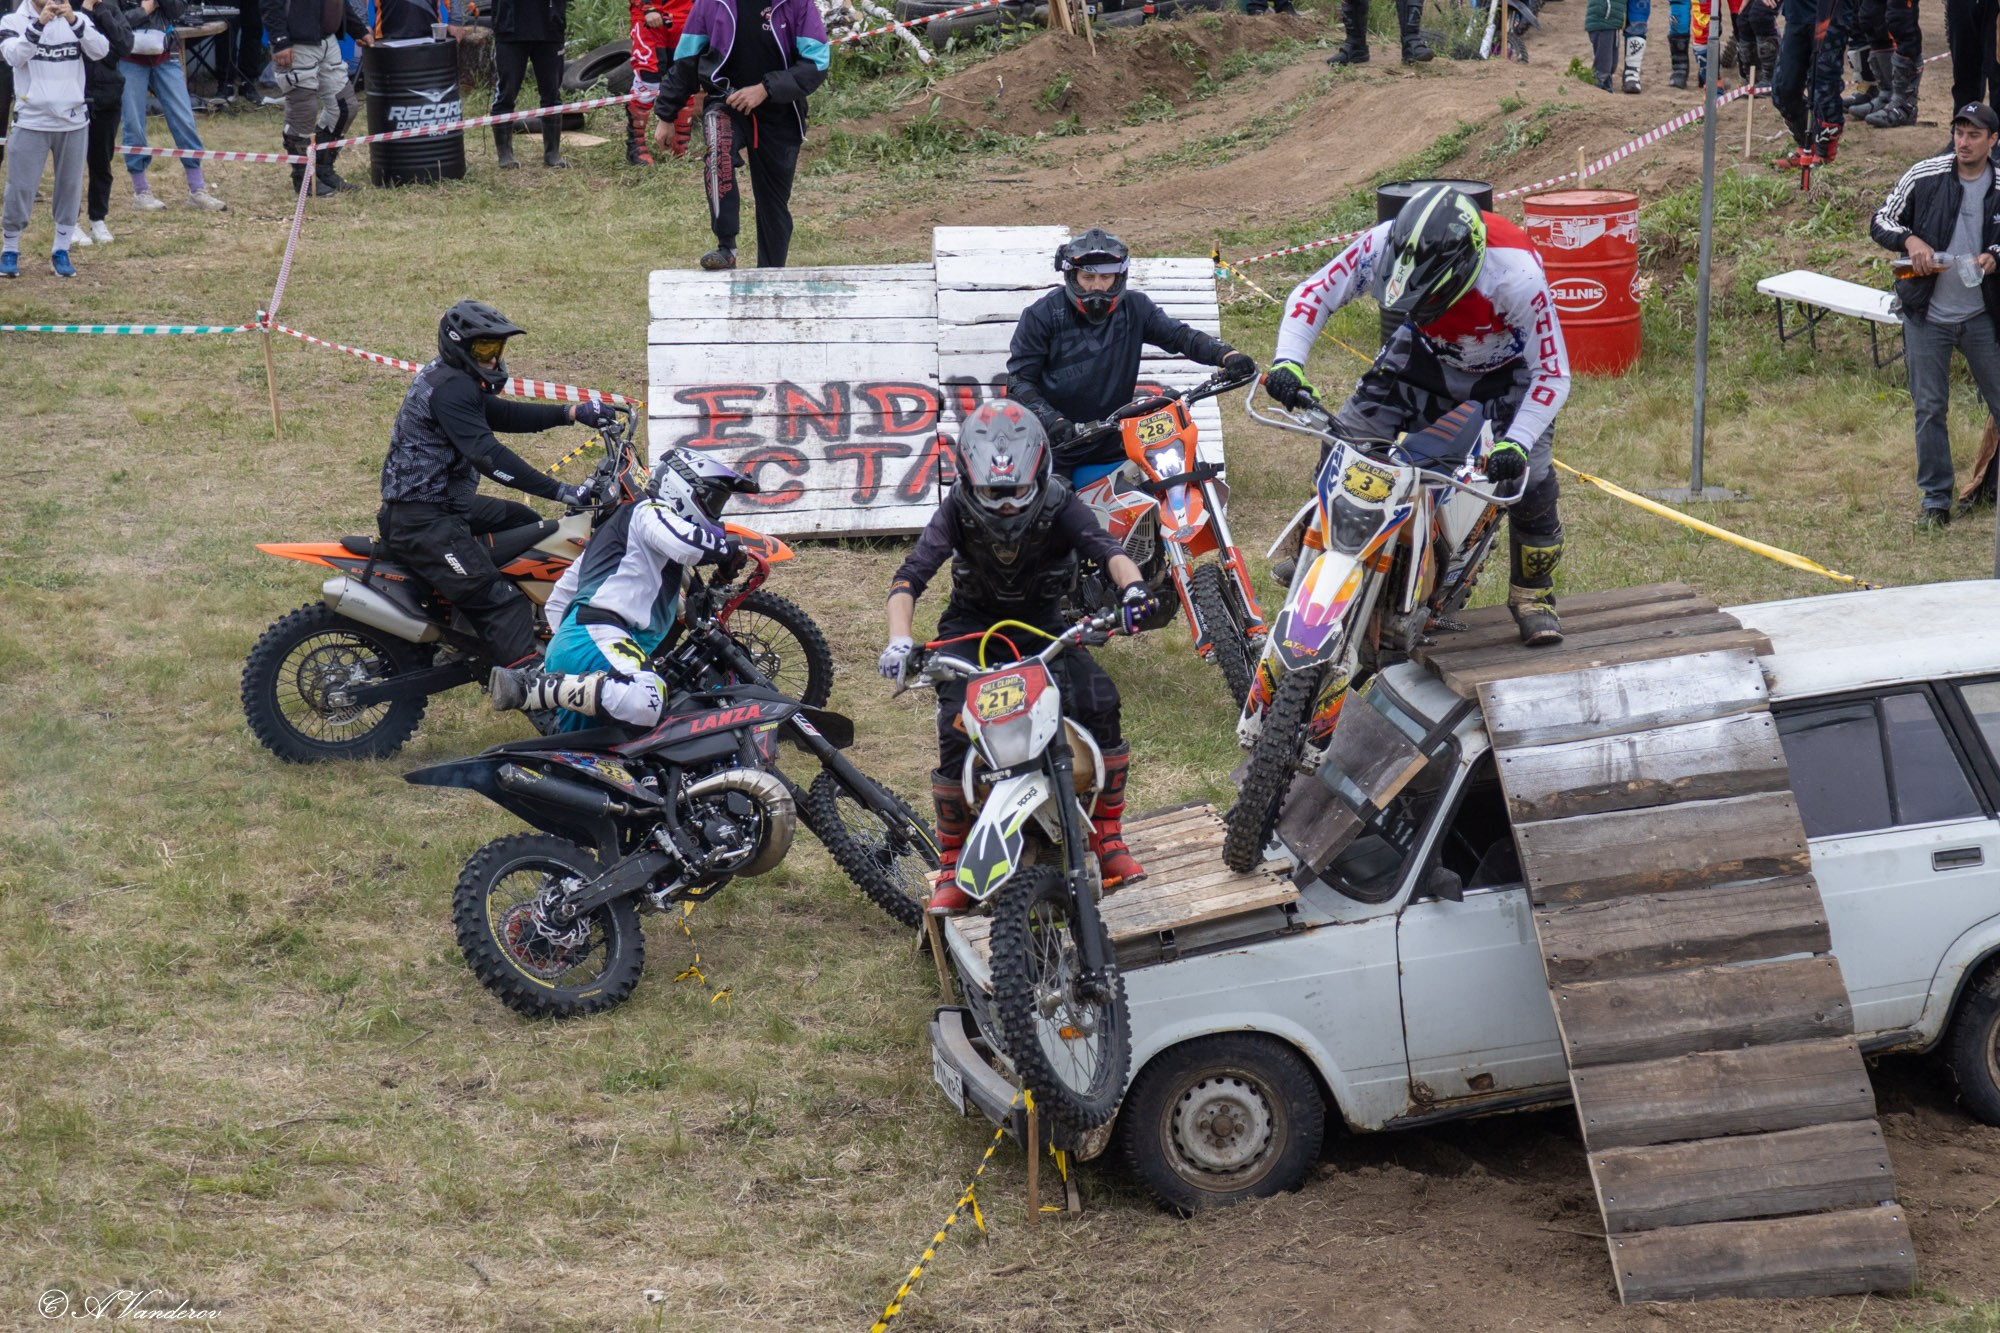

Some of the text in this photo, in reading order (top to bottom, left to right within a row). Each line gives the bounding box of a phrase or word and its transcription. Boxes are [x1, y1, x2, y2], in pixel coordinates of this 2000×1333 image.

[1147, 423, 1165, 438] 28
[666, 455, 709, 494] 100%
[1357, 460, 1371, 473] HILL
[1359, 475, 1374, 492] 3
[444, 553, 468, 576] LEATT
[988, 690, 1009, 709] 21
[690, 704, 761, 734] LANZA
